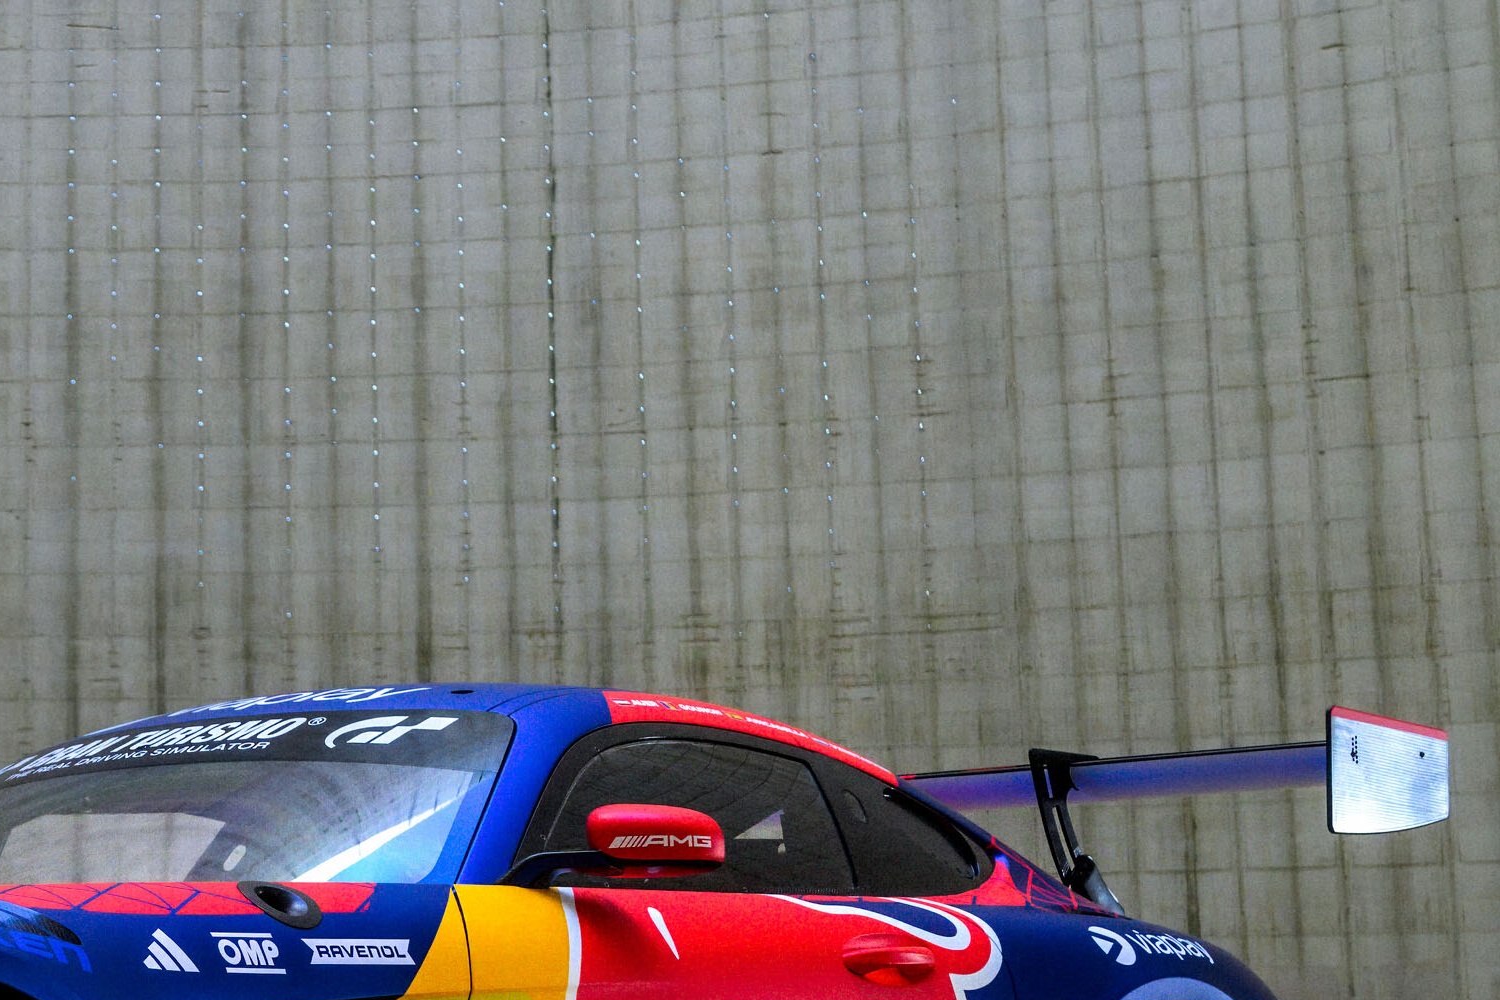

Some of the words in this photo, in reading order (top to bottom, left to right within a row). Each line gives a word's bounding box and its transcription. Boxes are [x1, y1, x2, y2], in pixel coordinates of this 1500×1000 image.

[74, 750, 148, 767] DRIVING
[150, 741, 271, 756] SIMULATOR
[217, 939, 280, 966] OMP
[315, 944, 407, 959] RAVENOL
[1125, 929, 1214, 964] viaplay
